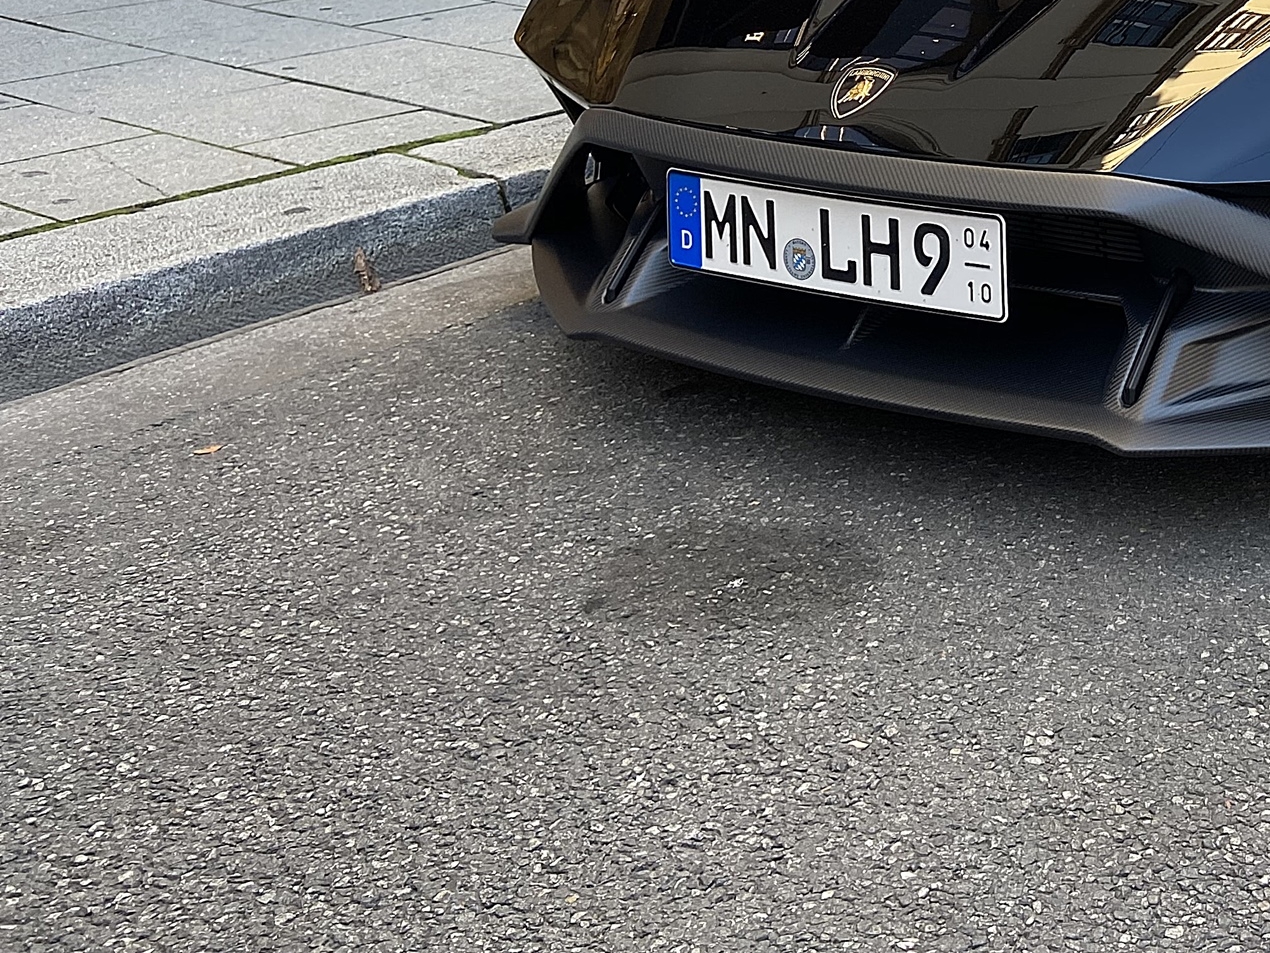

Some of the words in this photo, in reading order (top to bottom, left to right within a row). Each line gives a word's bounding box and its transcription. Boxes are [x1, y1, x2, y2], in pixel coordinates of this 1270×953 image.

[681, 229, 693, 250] D
[703, 190, 778, 270] MN
[963, 227, 991, 252] 04
[966, 281, 993, 305] 10
